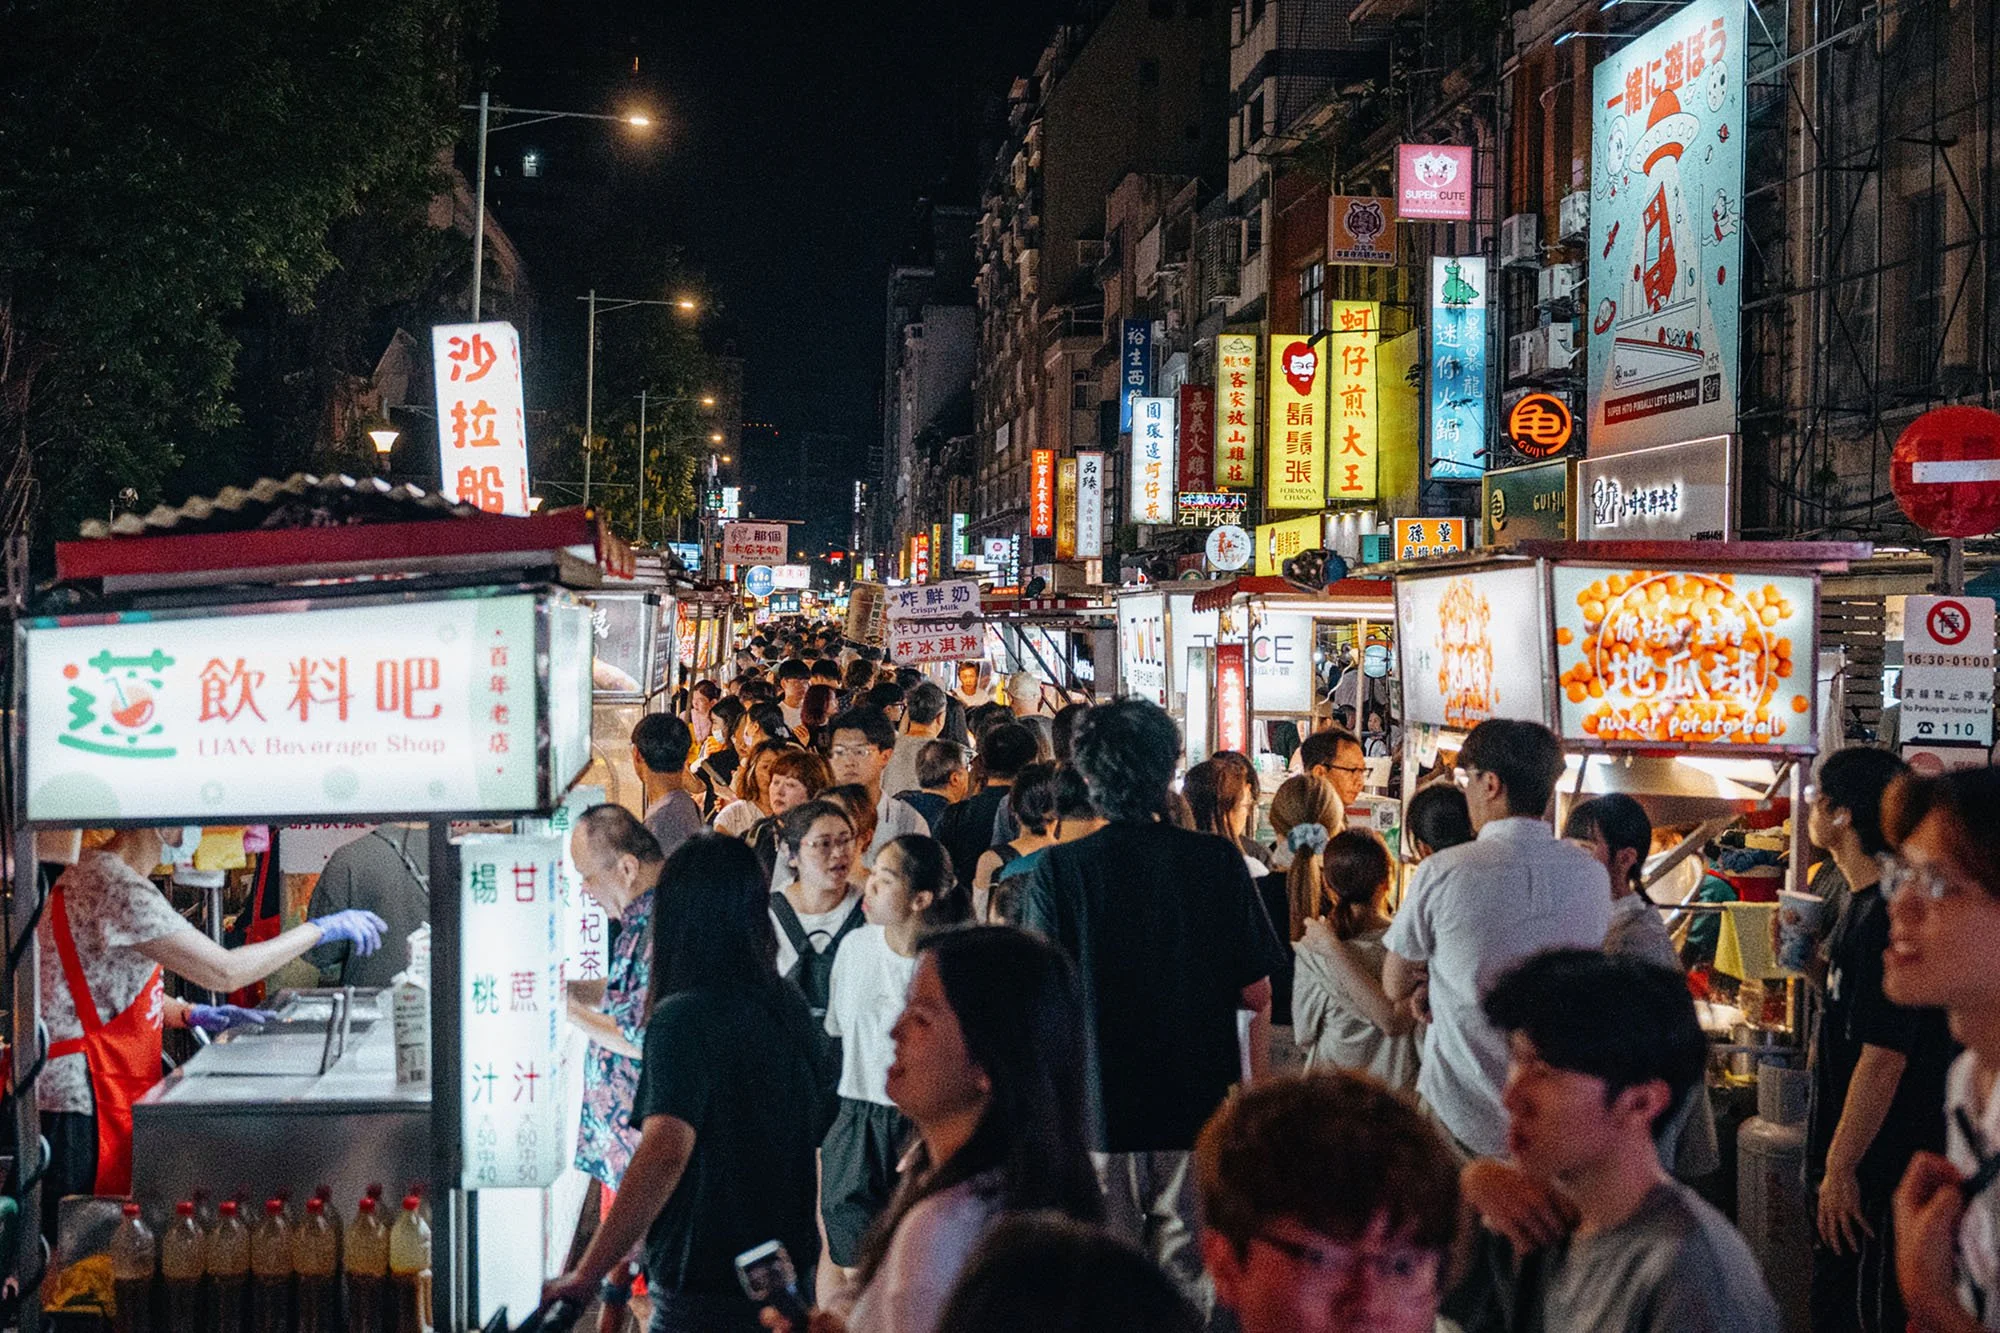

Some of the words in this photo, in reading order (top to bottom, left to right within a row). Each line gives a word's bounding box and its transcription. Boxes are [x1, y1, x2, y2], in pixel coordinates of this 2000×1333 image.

[1607, 17, 1727, 117] 一緒に遊ぼう
[1405, 189, 1438, 200] SUPER
[1439, 191, 1465, 201] CUTE
[1127, 327, 1147, 429] 裕生西
[1340, 308, 1371, 493] 蚵仔煎大王
[1434, 322, 1461, 475] 迷你火鍋城
[448, 333, 505, 513] 沙拉船
[1226, 372, 1248, 481] 客家放山雞莊
[1286, 402, 1313, 483] 鬍鬚張
[1518, 440, 1545, 457] GUIJI
[1145, 402, 1163, 519] 圓環邊蚵仔煎
[732, 543, 780, 555] 木瓜牛奶
[899, 586, 970, 608] 炸鮮奶
[910, 607, 937, 615] Crispy
[940, 604, 959, 612] Milk
[896, 635, 978, 656] 炸冰淇淋
[1907, 654, 1990, 668] 16:30-01:00
[198, 655, 443, 723] 飲料吧
[489, 645, 510, 753] 百年老店
[1606, 650, 1760, 702] 地瓜球
[1598, 713, 1661, 732] sweet
[1669, 715, 1736, 738] potato
[1740, 712, 1782, 735] ball
[1904, 704, 1913, 712] No
[1914, 705, 1940, 714] Parking
[1952, 706, 1973, 714] Yellow
[1974, 707, 1988, 715] Line
[1943, 723, 1974, 736] 110
[265, 736, 377, 758] Beverage
[387, 734, 446, 757] Shop
[471, 862, 501, 1104] 楊桃汁
[512, 862, 541, 1103] 甘蔗汁
[518, 1165, 537, 1181] 50
